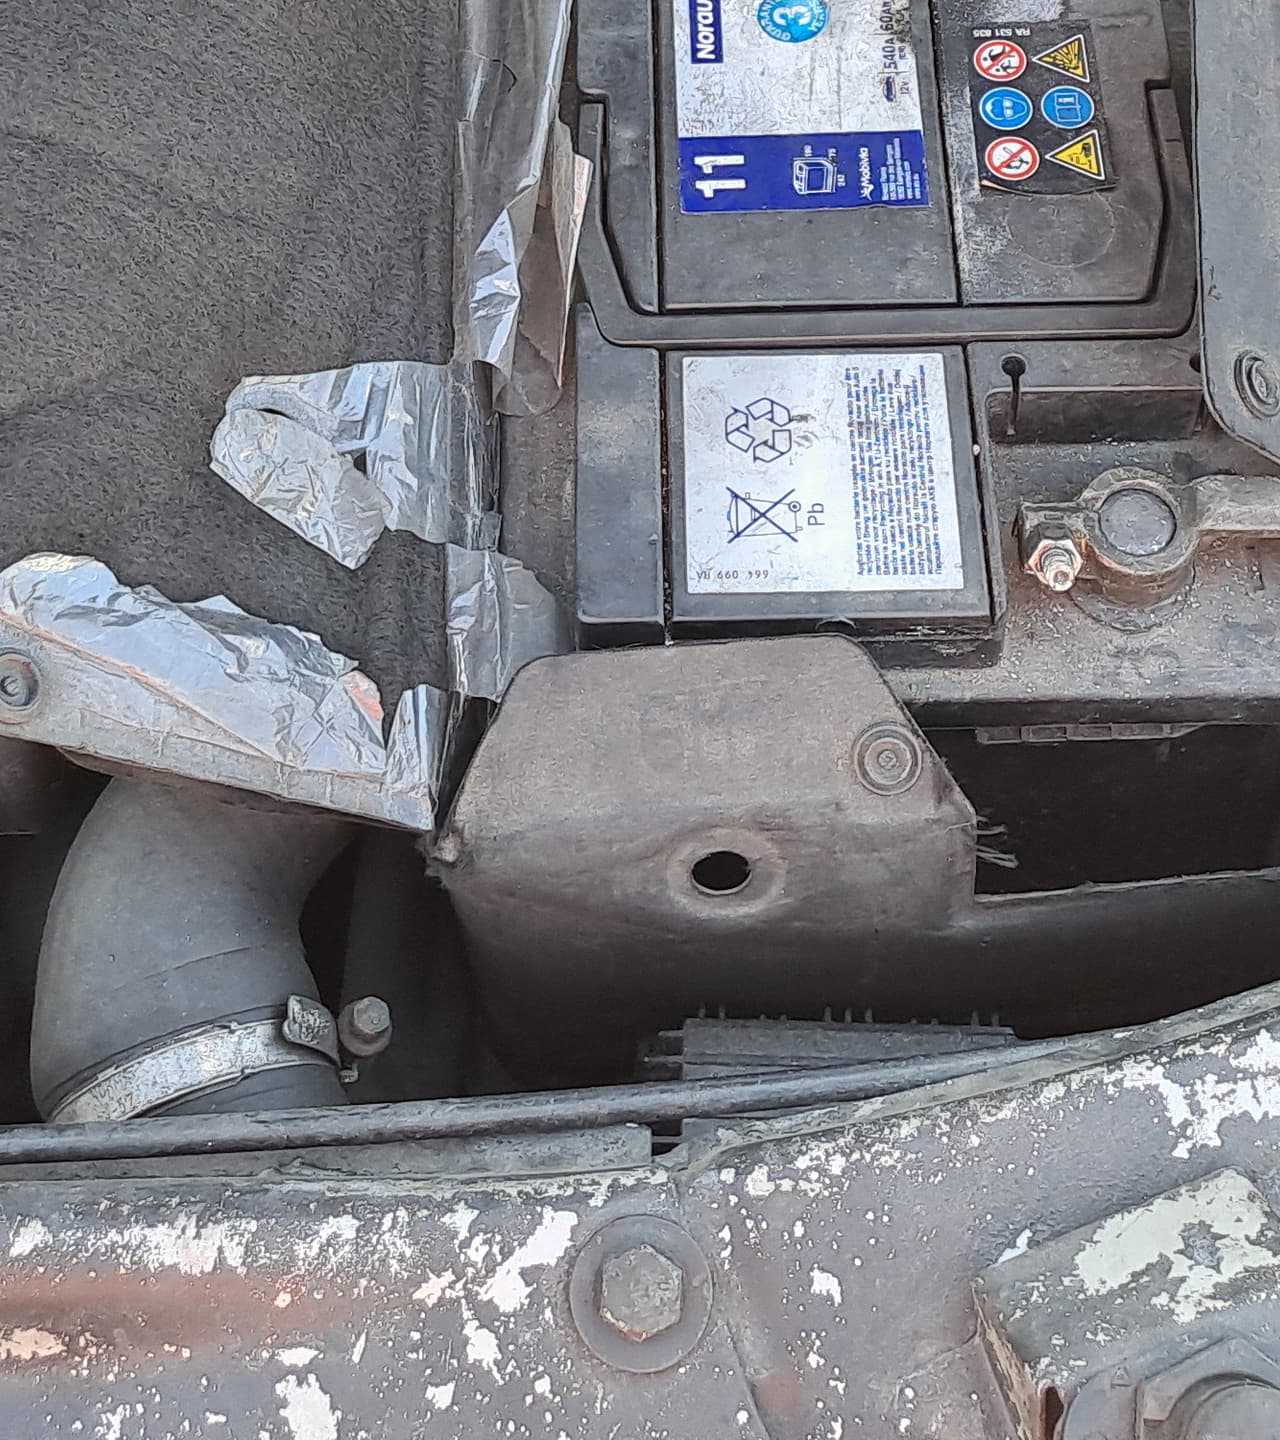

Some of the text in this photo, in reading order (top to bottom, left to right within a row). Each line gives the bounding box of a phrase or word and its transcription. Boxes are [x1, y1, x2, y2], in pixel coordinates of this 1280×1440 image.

[772, 5, 811, 26] 3
[694, 154, 746, 199] 11
[807, 502, 826, 526] Pb
